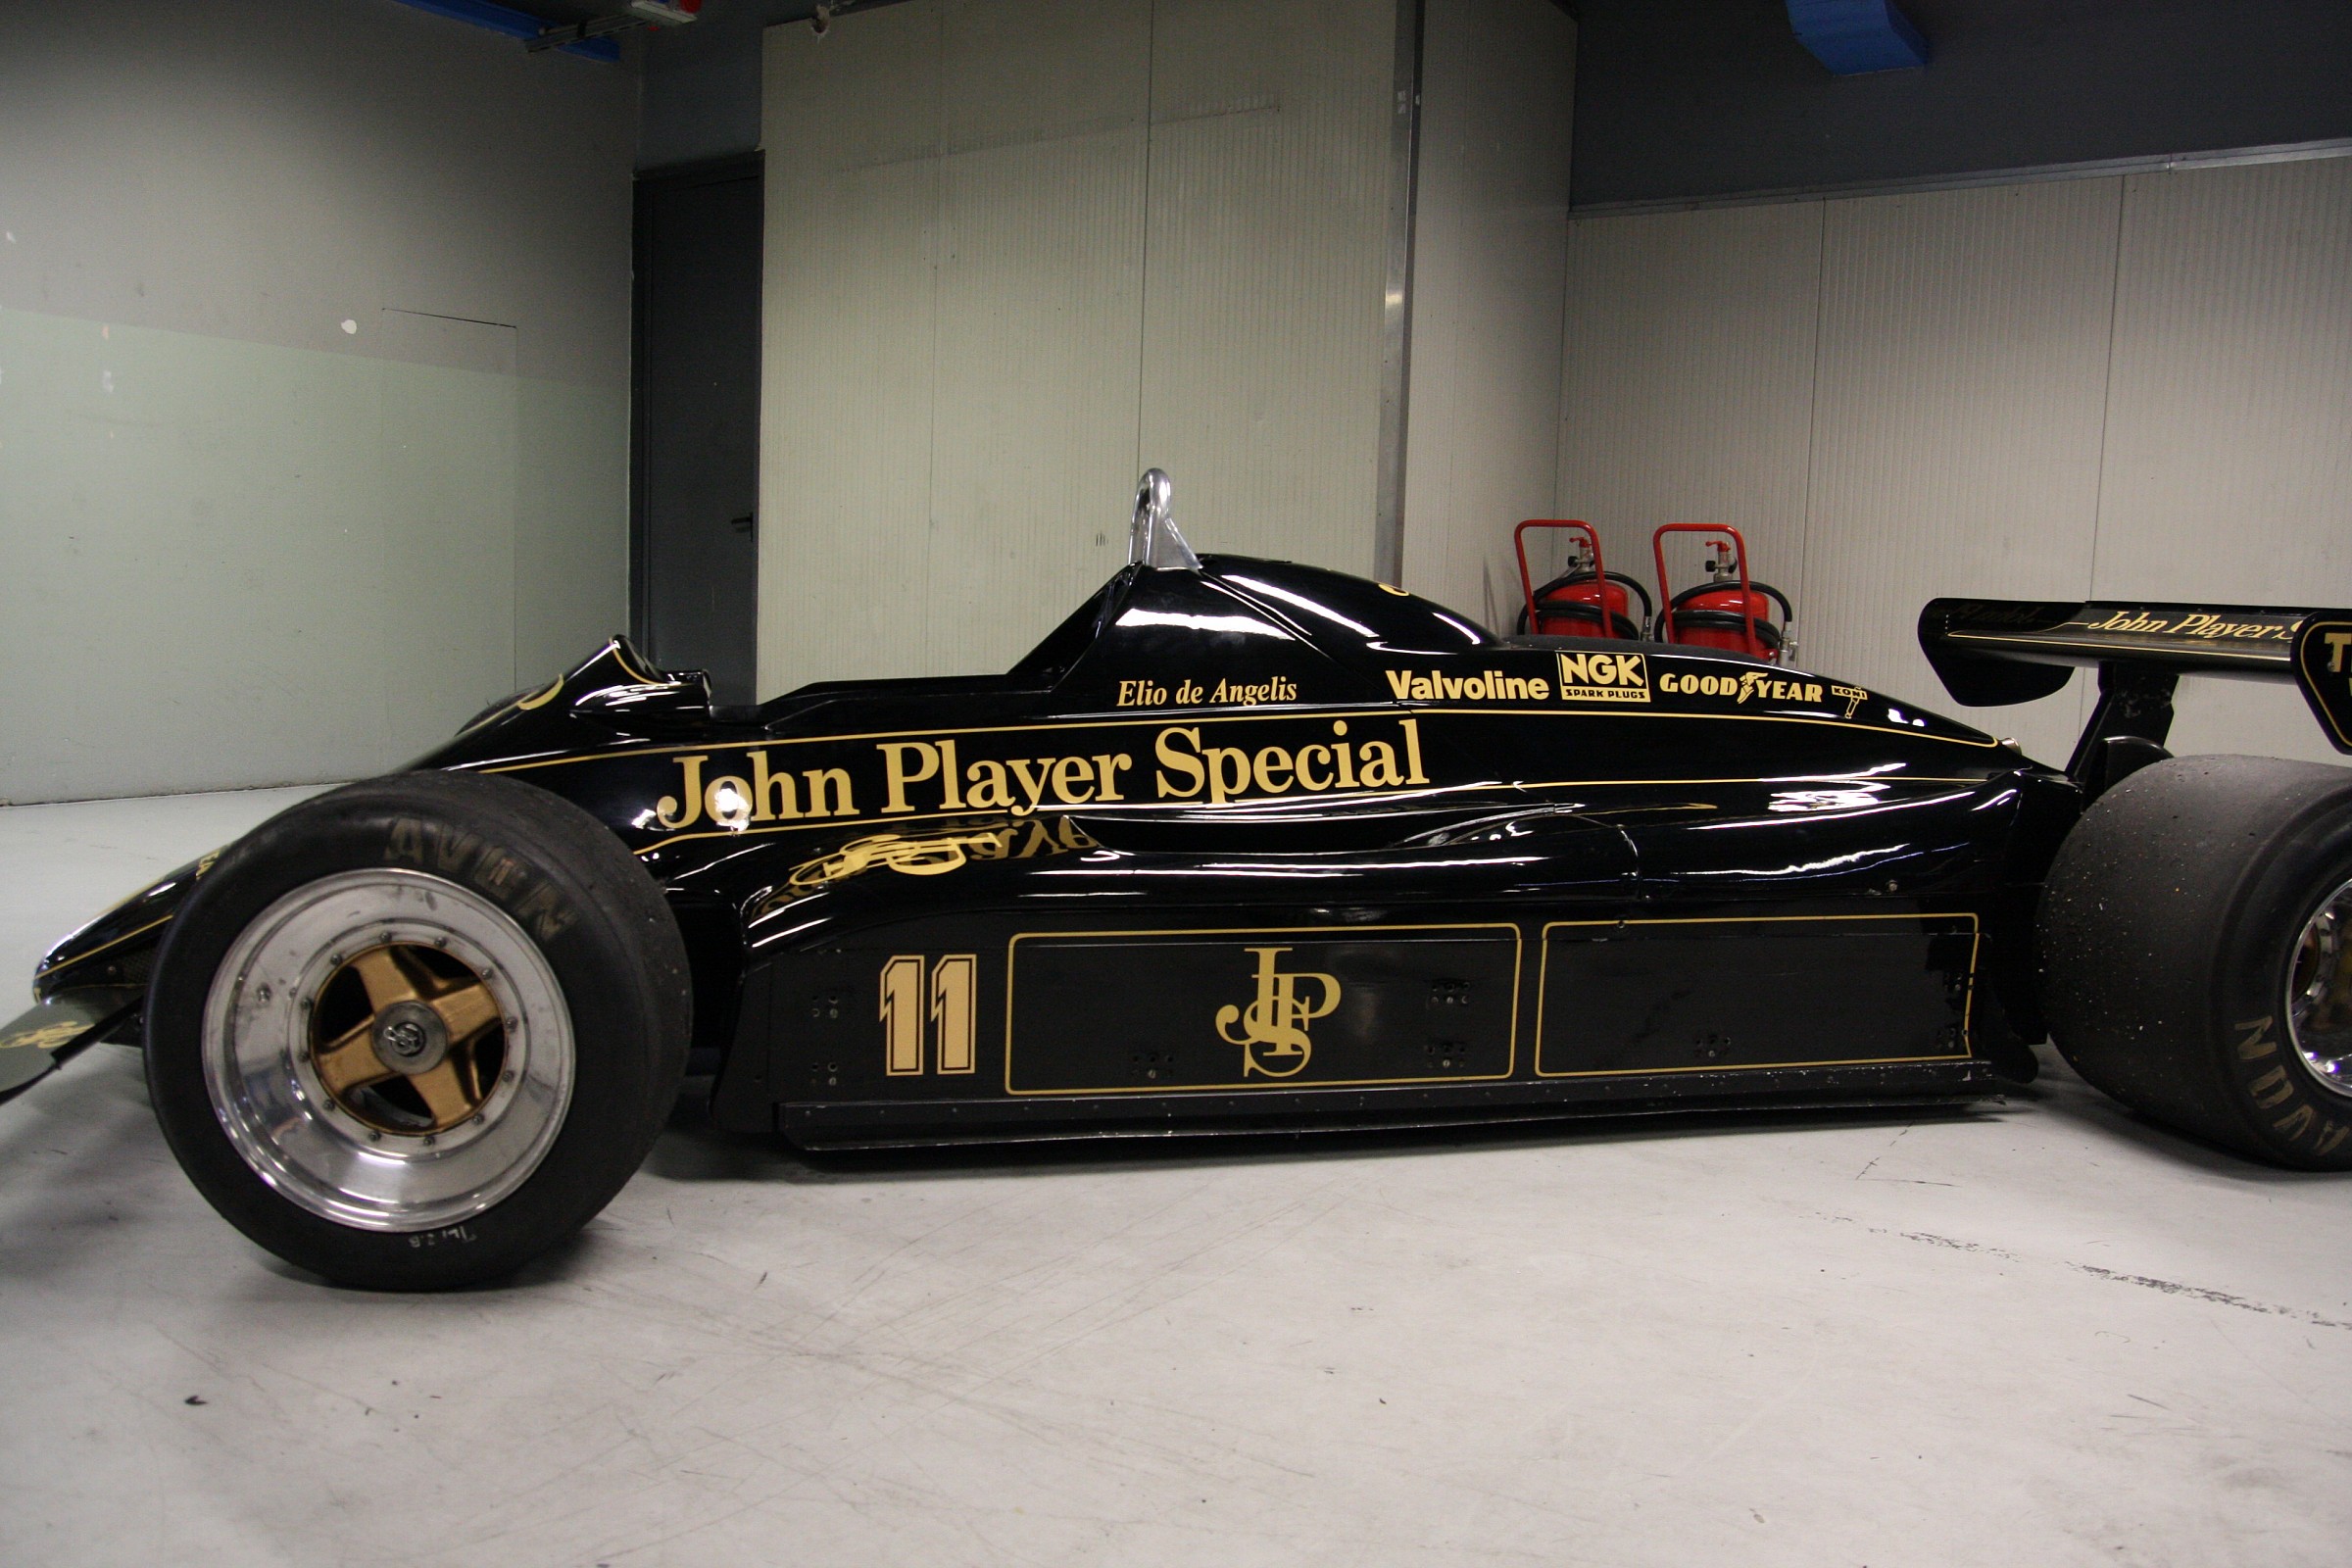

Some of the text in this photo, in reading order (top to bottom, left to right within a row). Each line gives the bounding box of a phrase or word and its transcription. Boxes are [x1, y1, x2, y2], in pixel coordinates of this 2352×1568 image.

[2088, 611, 2168, 632] John
[2163, 613, 2277, 639] Player
[1385, 669, 1550, 700] Valvoline
[1560, 653, 1644, 687] NGK
[1116, 675, 1297, 707] Elio de Angelis
[1565, 688, 1645, 699] SPARK PLUGS
[1833, 686, 1867, 700] KONI
[656, 719, 1431, 830] John Player Special
[879, 954, 978, 1076] 11
[2233, 1015, 2350, 1156] AVON
